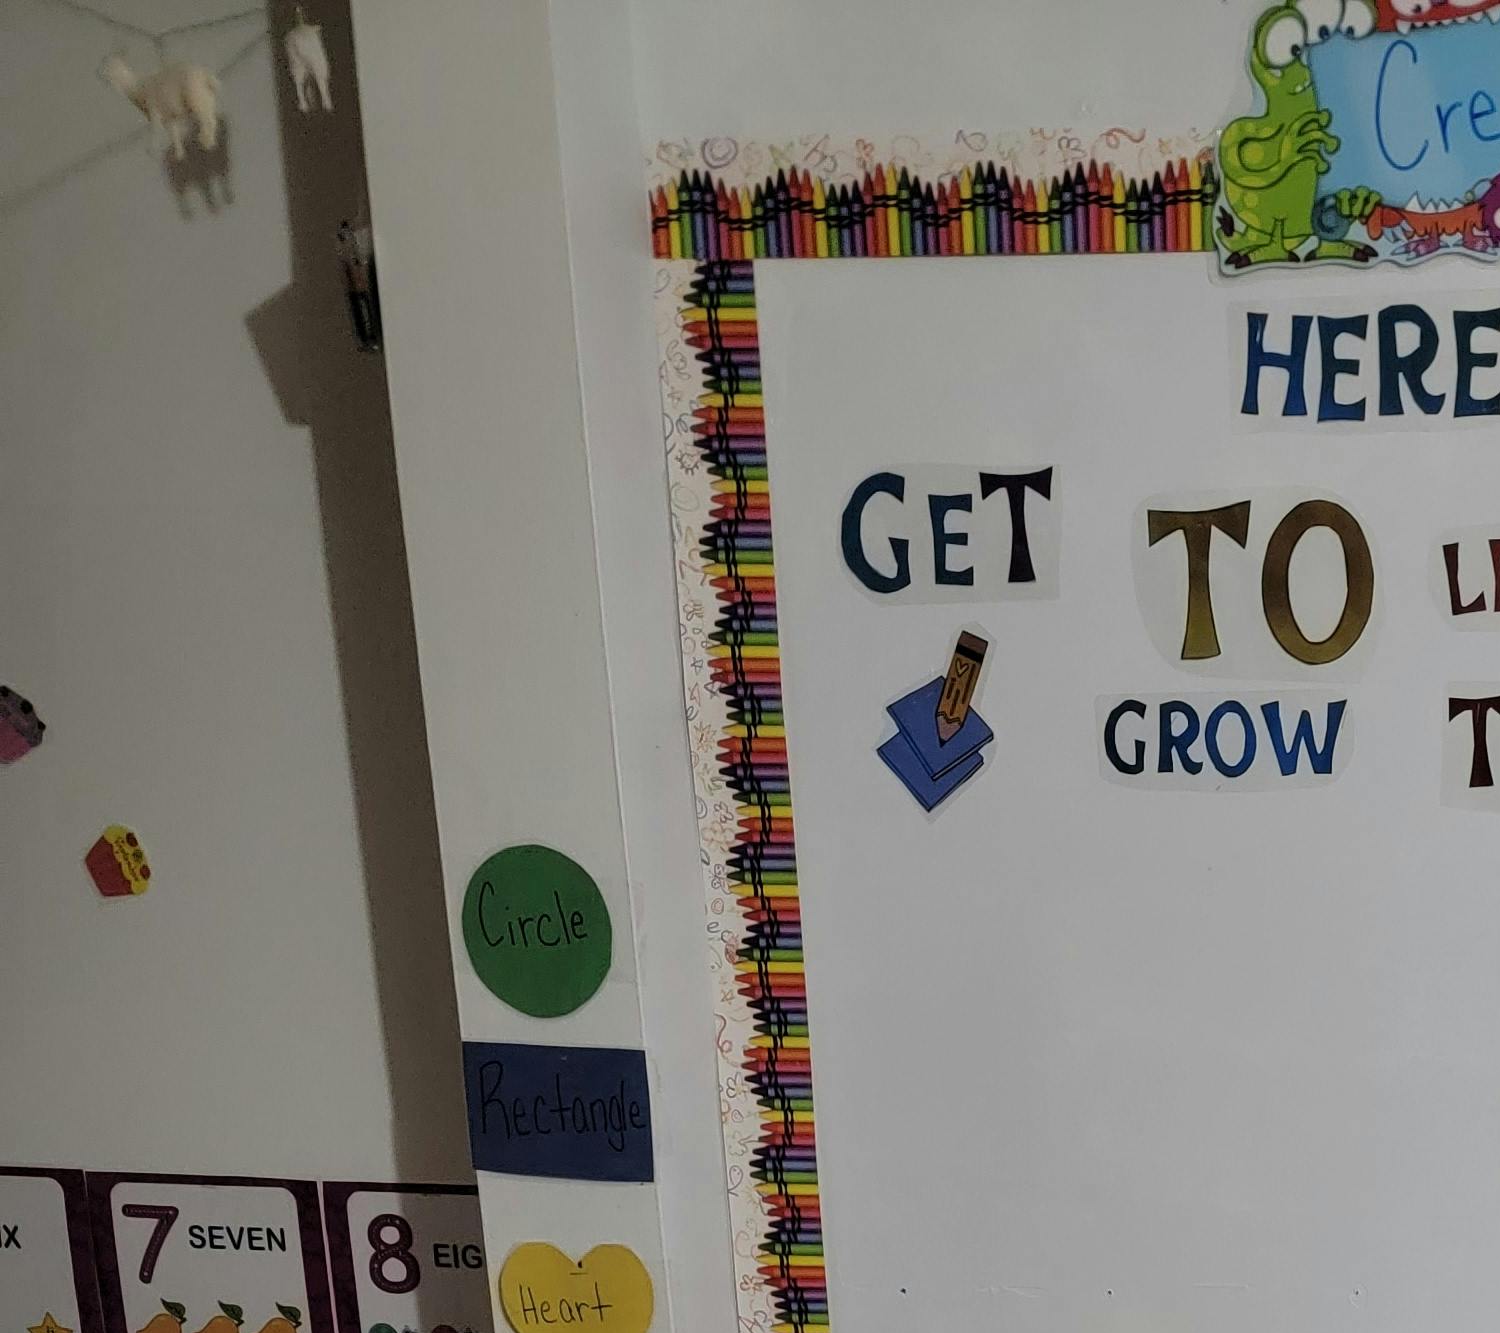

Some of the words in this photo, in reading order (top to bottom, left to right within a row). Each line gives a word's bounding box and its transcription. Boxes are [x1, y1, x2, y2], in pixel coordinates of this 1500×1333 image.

[841, 467, 1052, 594] GET
[1147, 500, 1375, 666] TO
[1104, 698, 1347, 778] GROW
[478, 881, 587, 949] Circle
[479, 1061, 647, 1152] Rectangle
[122, 1204, 179, 1284] 7
[188, 1225, 287, 1252] SEVEN
[367, 1214, 421, 1294] 8
[519, 1284, 613, 1325] Heart
